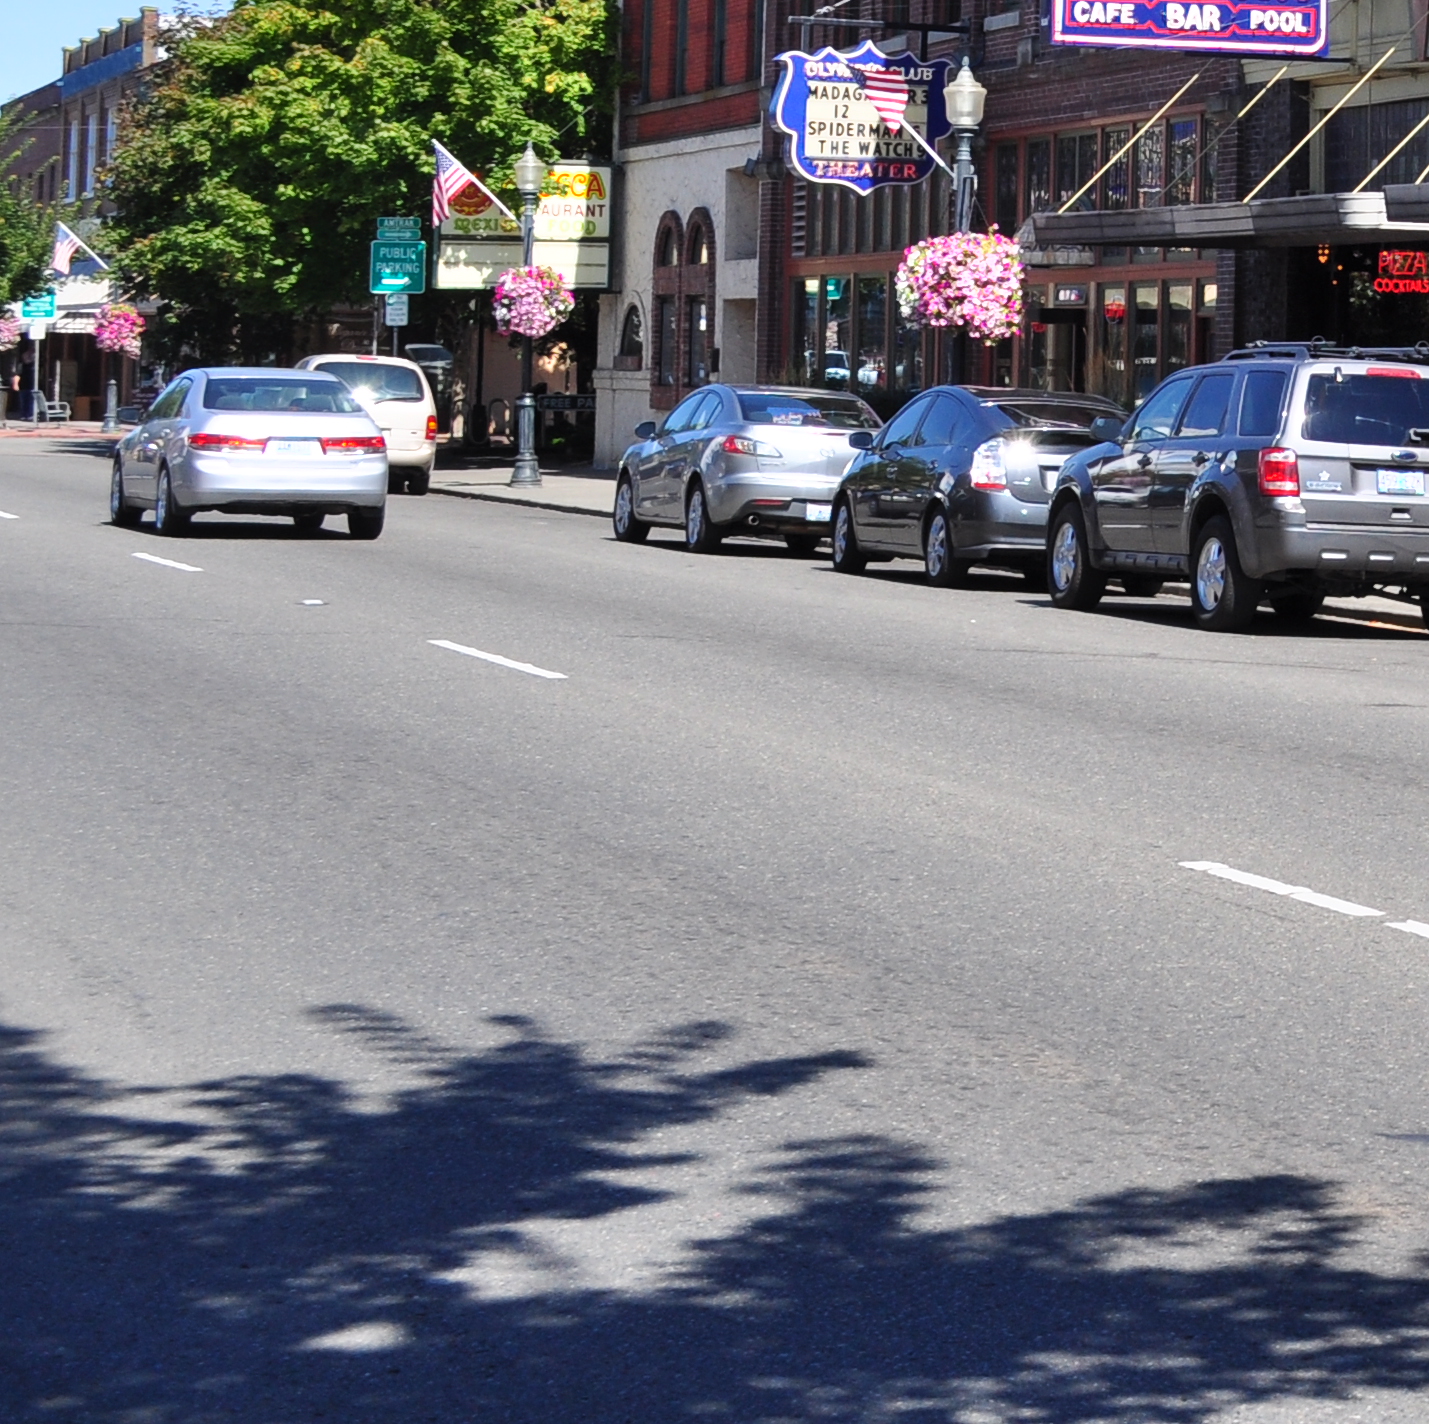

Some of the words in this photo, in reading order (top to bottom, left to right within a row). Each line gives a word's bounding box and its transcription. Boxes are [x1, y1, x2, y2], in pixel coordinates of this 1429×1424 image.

[1073, 0, 1138, 25] CAFE
[1165, 2, 1221, 31] BAR
[1249, 9, 1309, 33] POOL
[834, 104, 849, 119] 12
[808, 120, 903, 139] SPIDERMAN
[819, 140, 849, 155] THE
[859, 141, 913, 158] WATCH
[917, 143, 927, 159] 9
[813, 160, 918, 178] THEATER
[547, 219, 597, 236] FOOD
[380, 247, 416, 259] PUBLIC
[376, 262, 420, 274] PARKING
[1378, 251, 1427, 275] PIZZA
[1374, 278, 1429, 293] COCKTAILS
[543, 398, 571, 408] FREE
